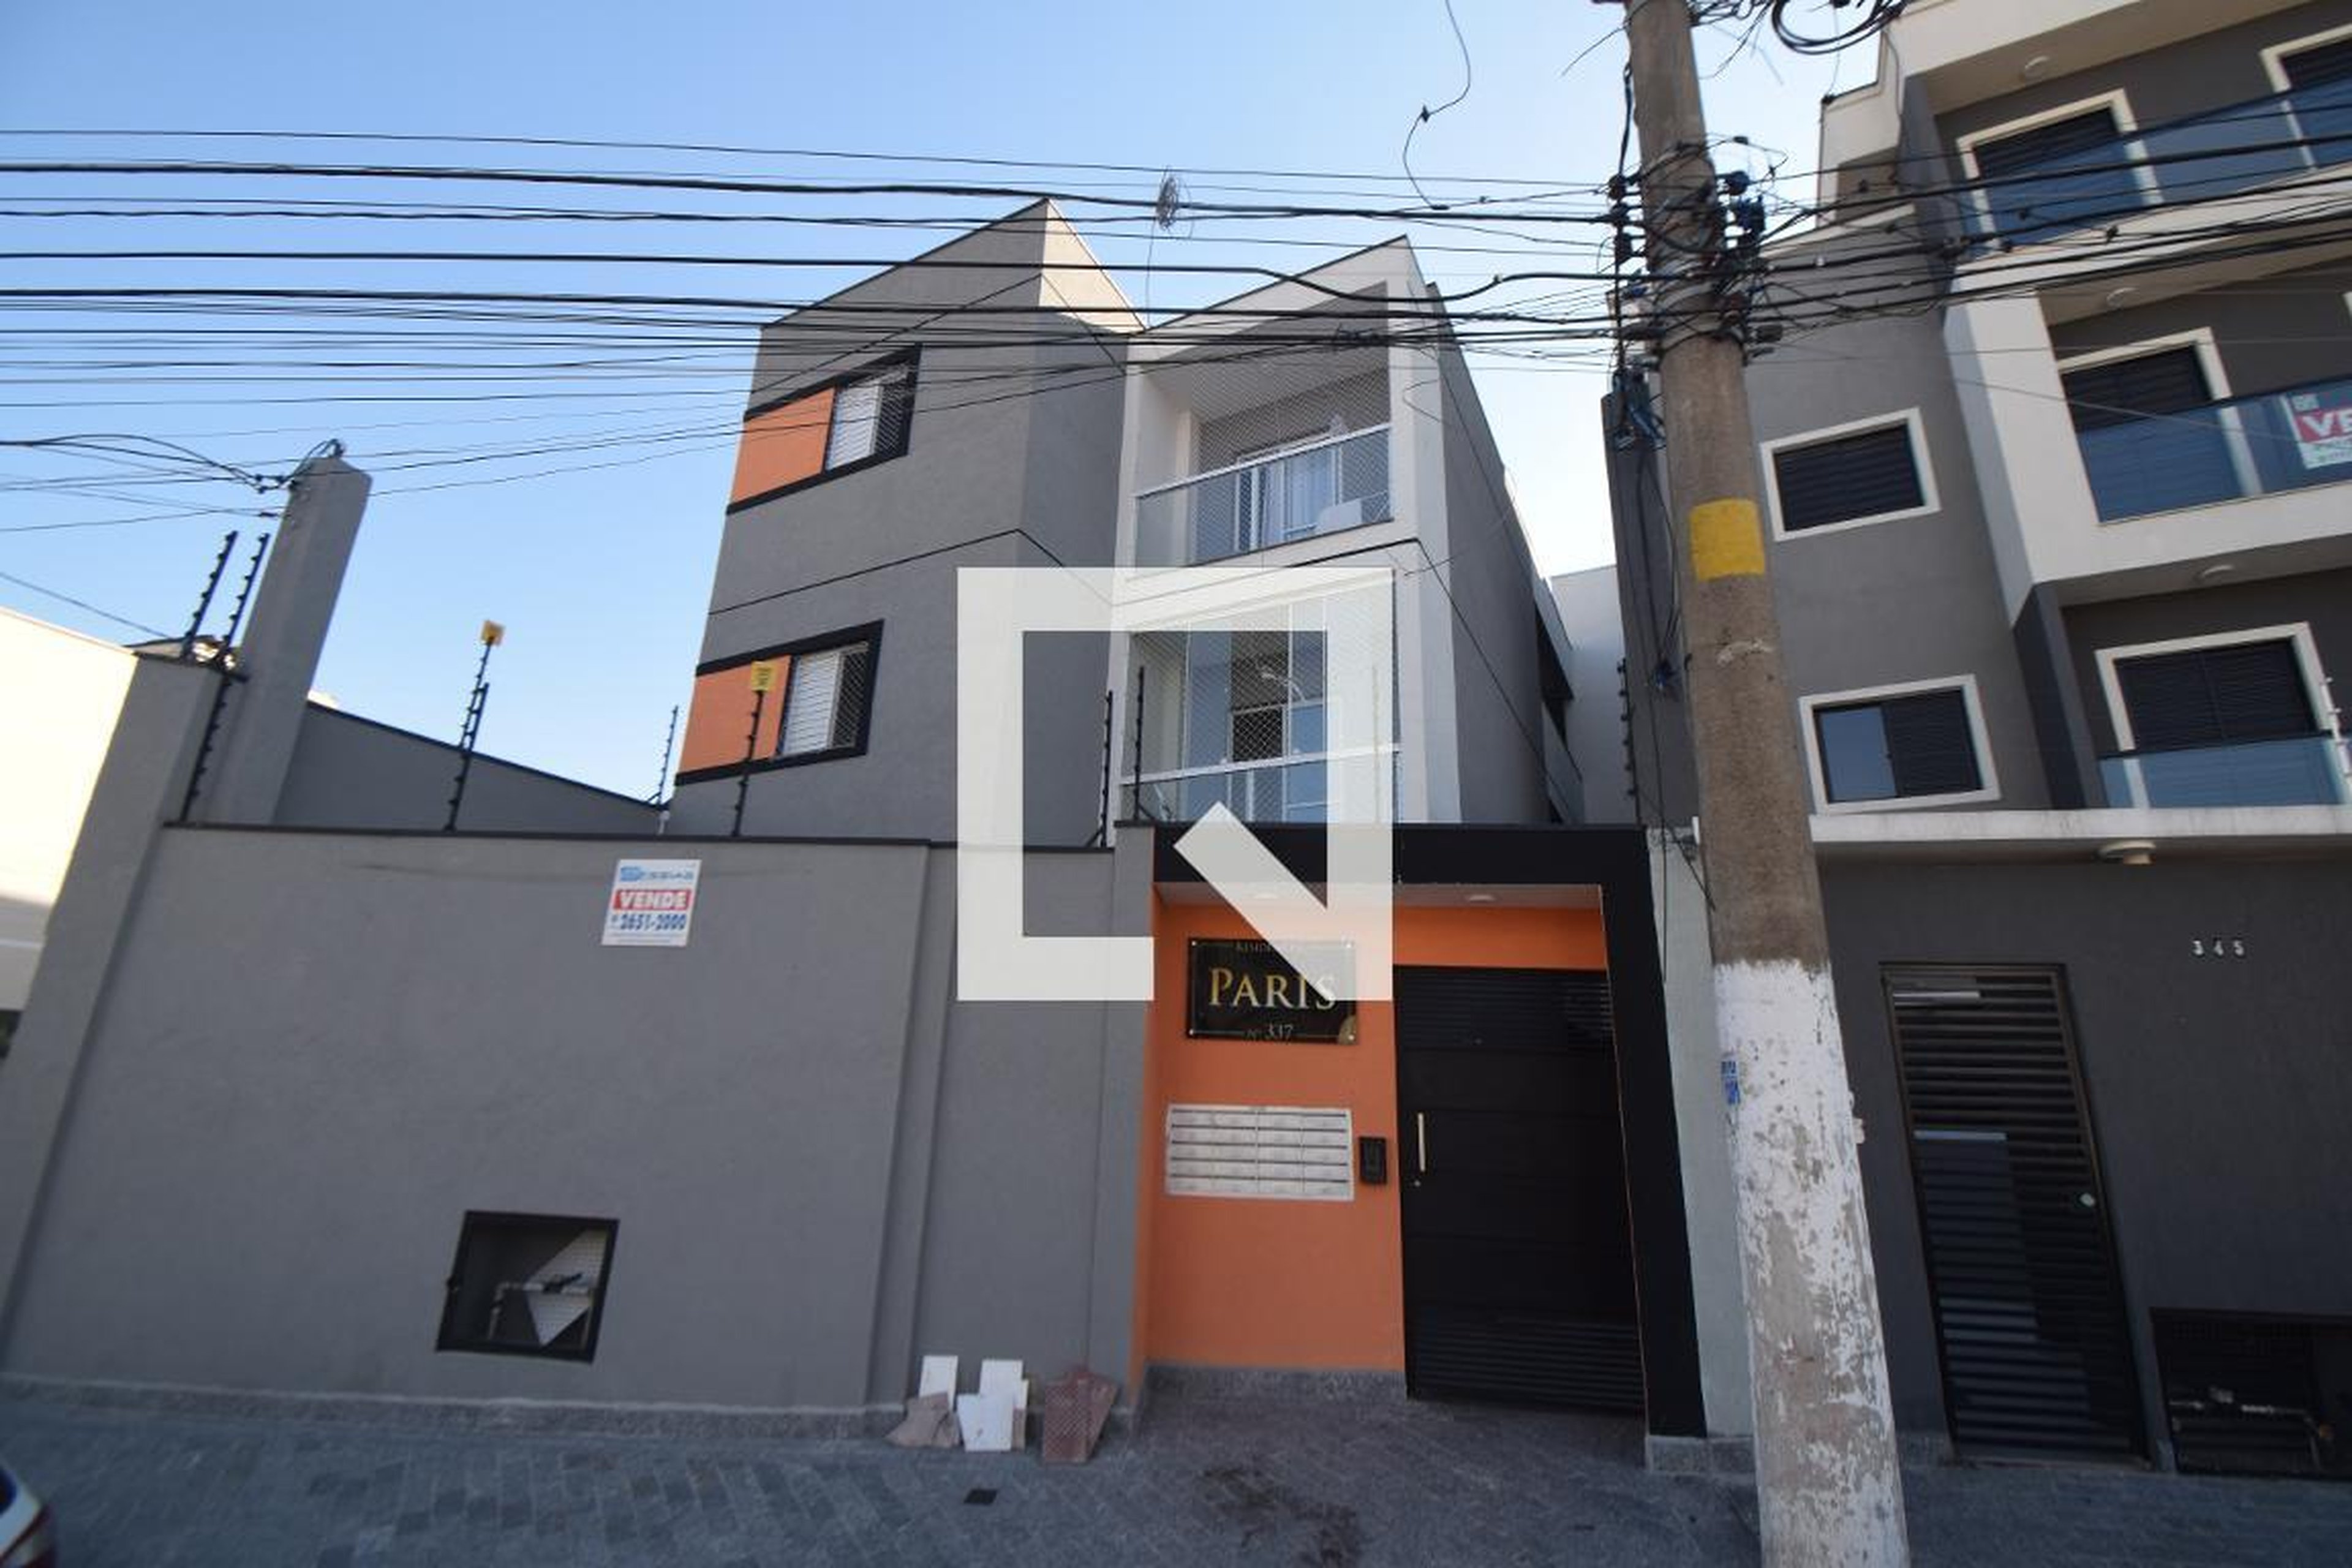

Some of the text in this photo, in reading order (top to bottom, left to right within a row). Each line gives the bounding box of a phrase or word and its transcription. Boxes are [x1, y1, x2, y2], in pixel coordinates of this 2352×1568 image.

[619, 891, 687, 909] VENDE
[2192, 940, 2245, 956] 345
[1208, 967, 1336, 1009] PARIS
